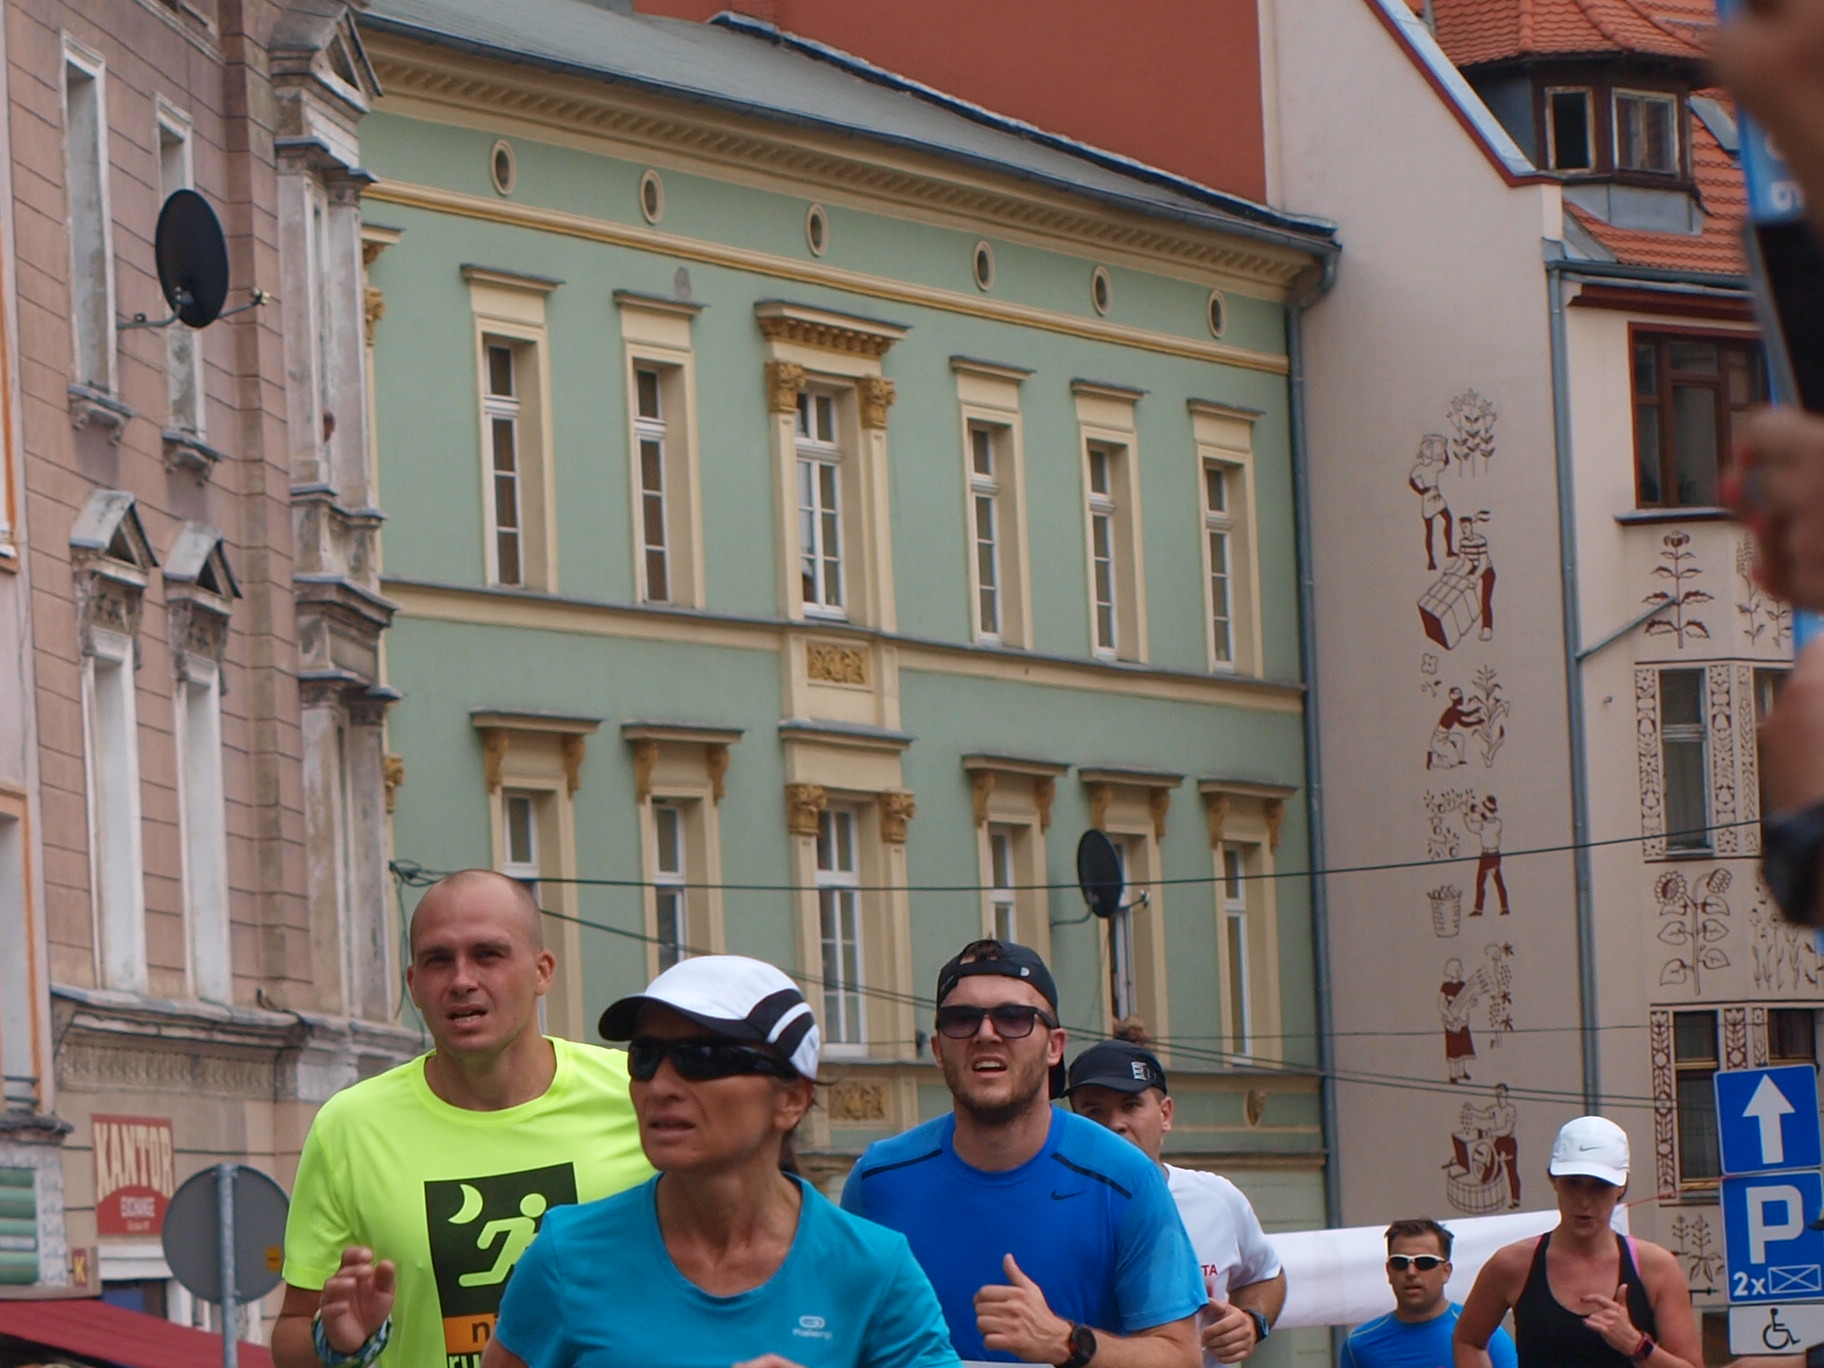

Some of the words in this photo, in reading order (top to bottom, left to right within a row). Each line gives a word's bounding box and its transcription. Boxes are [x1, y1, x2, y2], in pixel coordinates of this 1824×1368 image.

[93, 1122, 174, 1204] KANTOR
[1745, 1185, 1804, 1264] P
[73, 1256, 86, 1281] K
[1733, 1271, 1767, 1296] 2x
